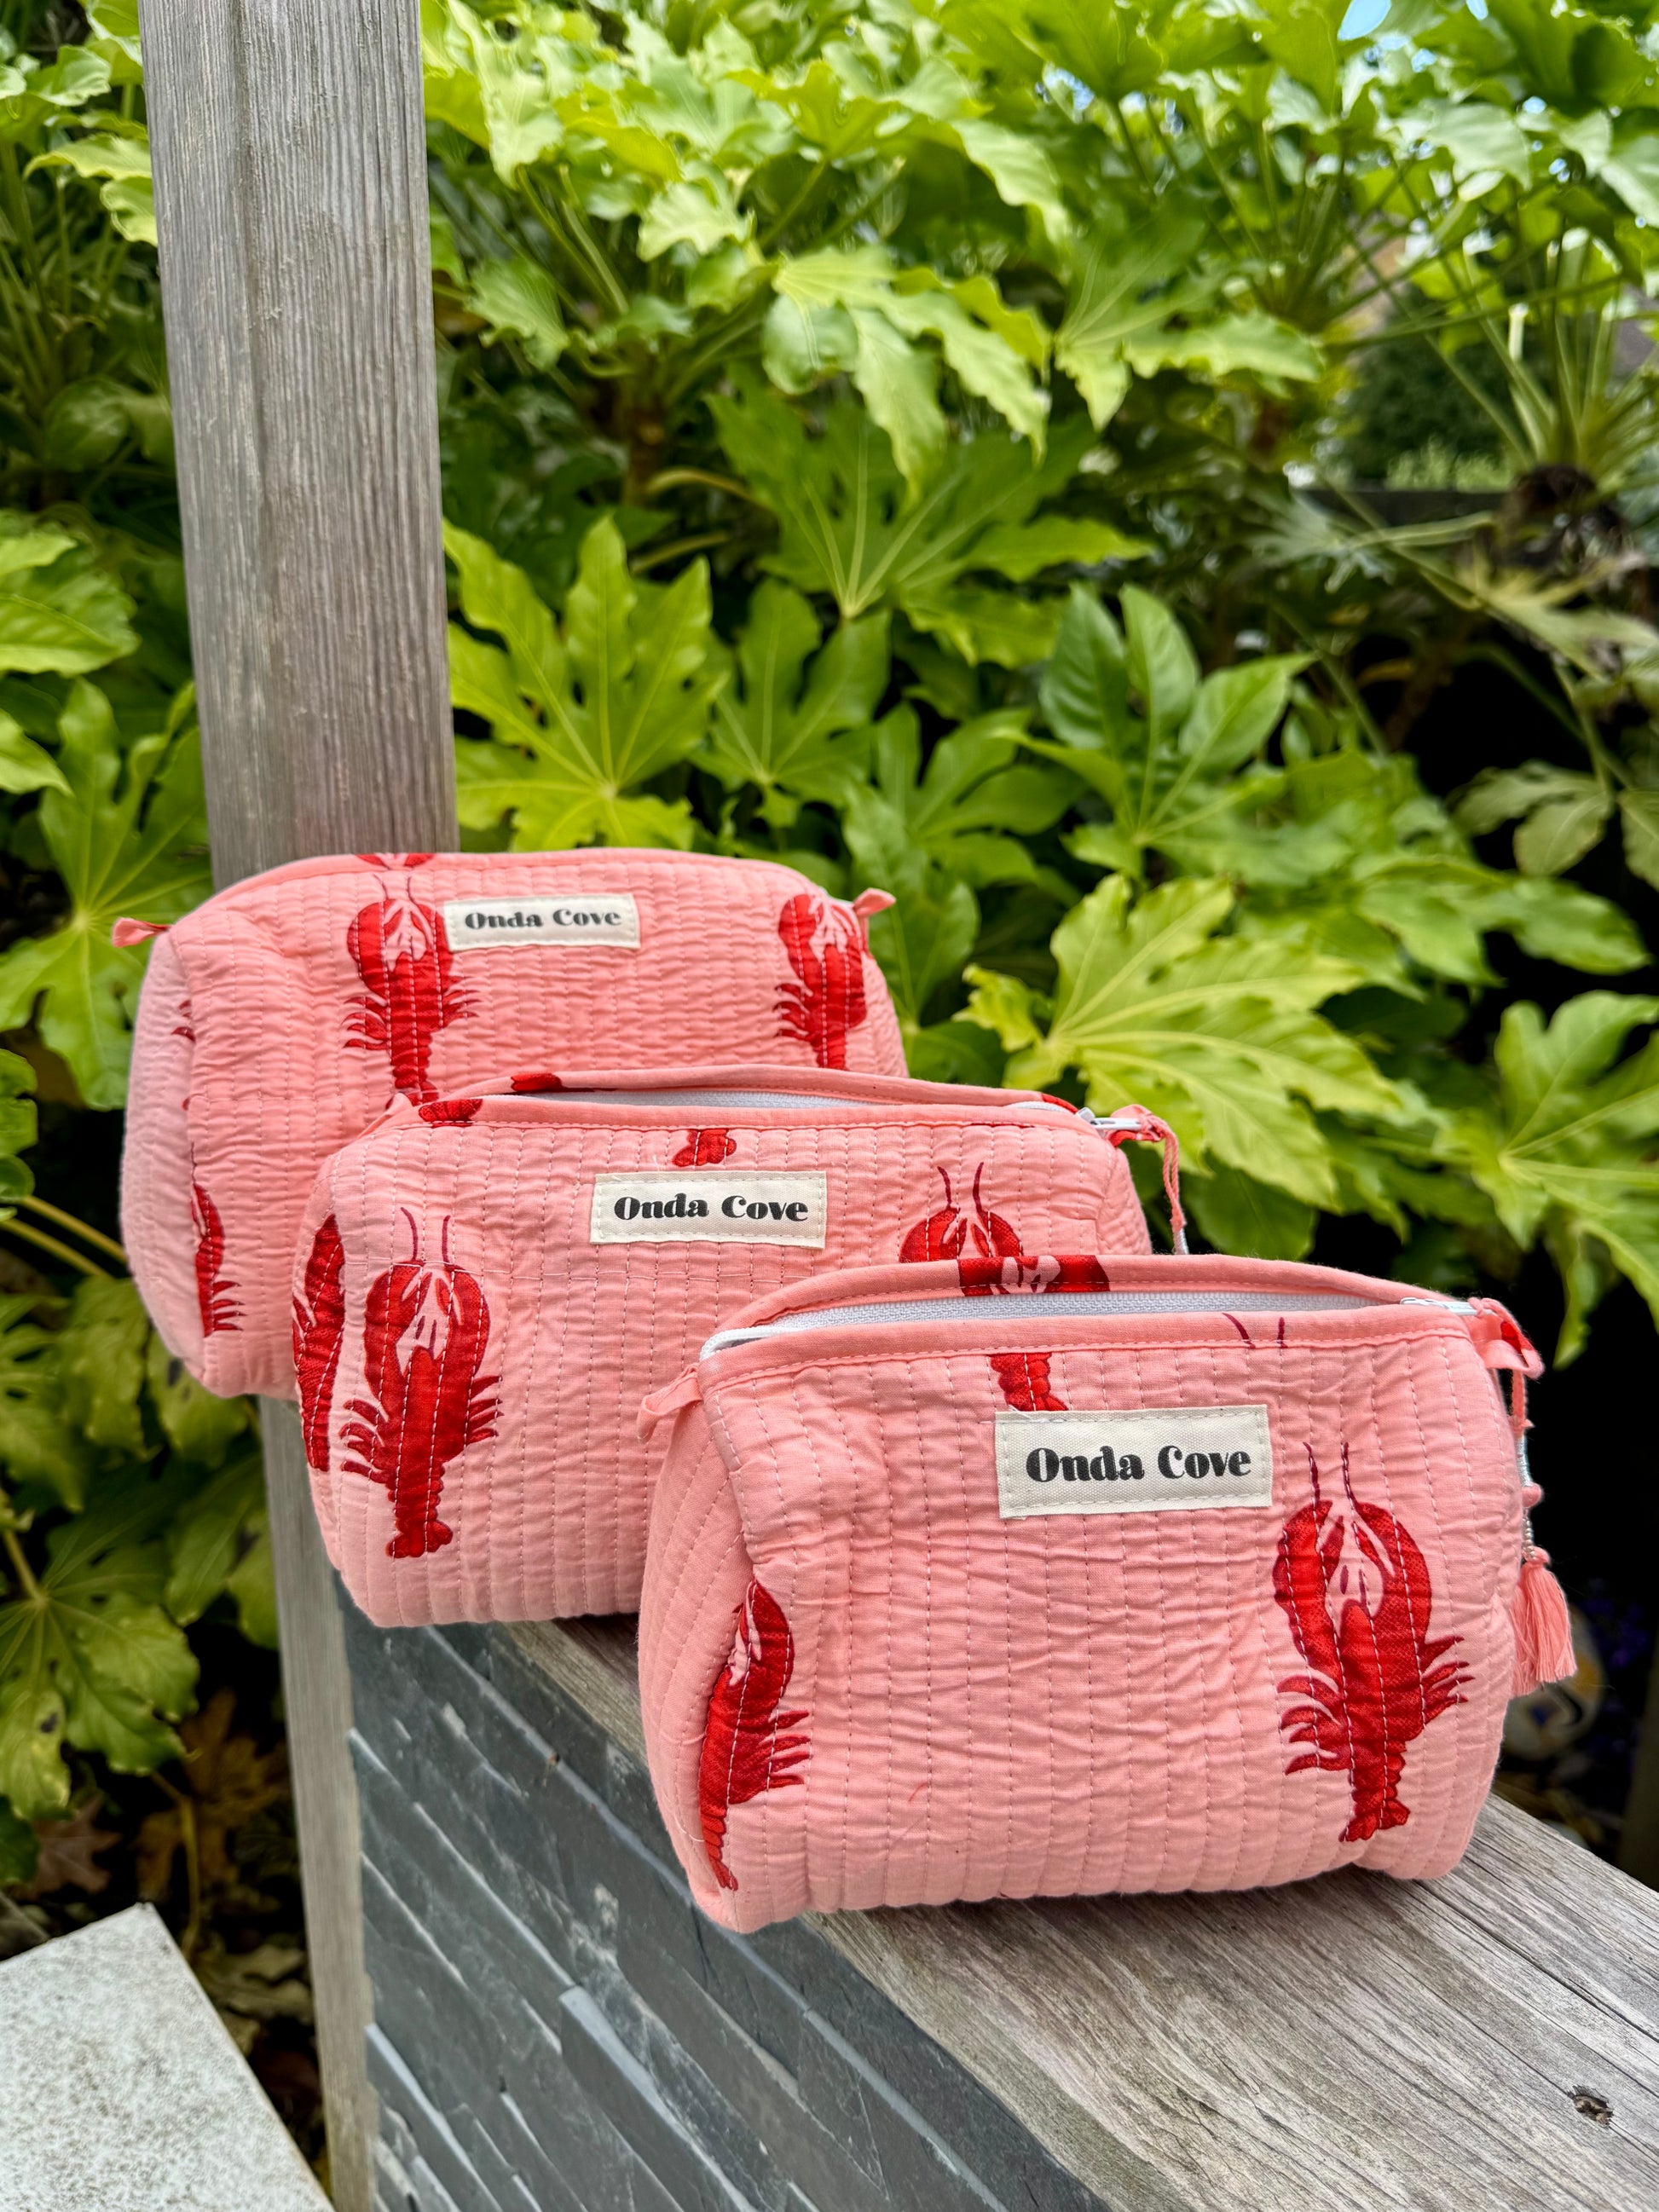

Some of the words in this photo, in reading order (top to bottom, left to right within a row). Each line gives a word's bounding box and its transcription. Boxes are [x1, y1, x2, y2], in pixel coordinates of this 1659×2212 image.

[465, 910, 544, 930] Onda
[552, 908, 622, 927] Cove
[613, 1193, 709, 1221] Onda
[720, 1195, 809, 1222] Cove
[1026, 1445, 1146, 1484] Onda
[1157, 1444, 1253, 1481] Cove
